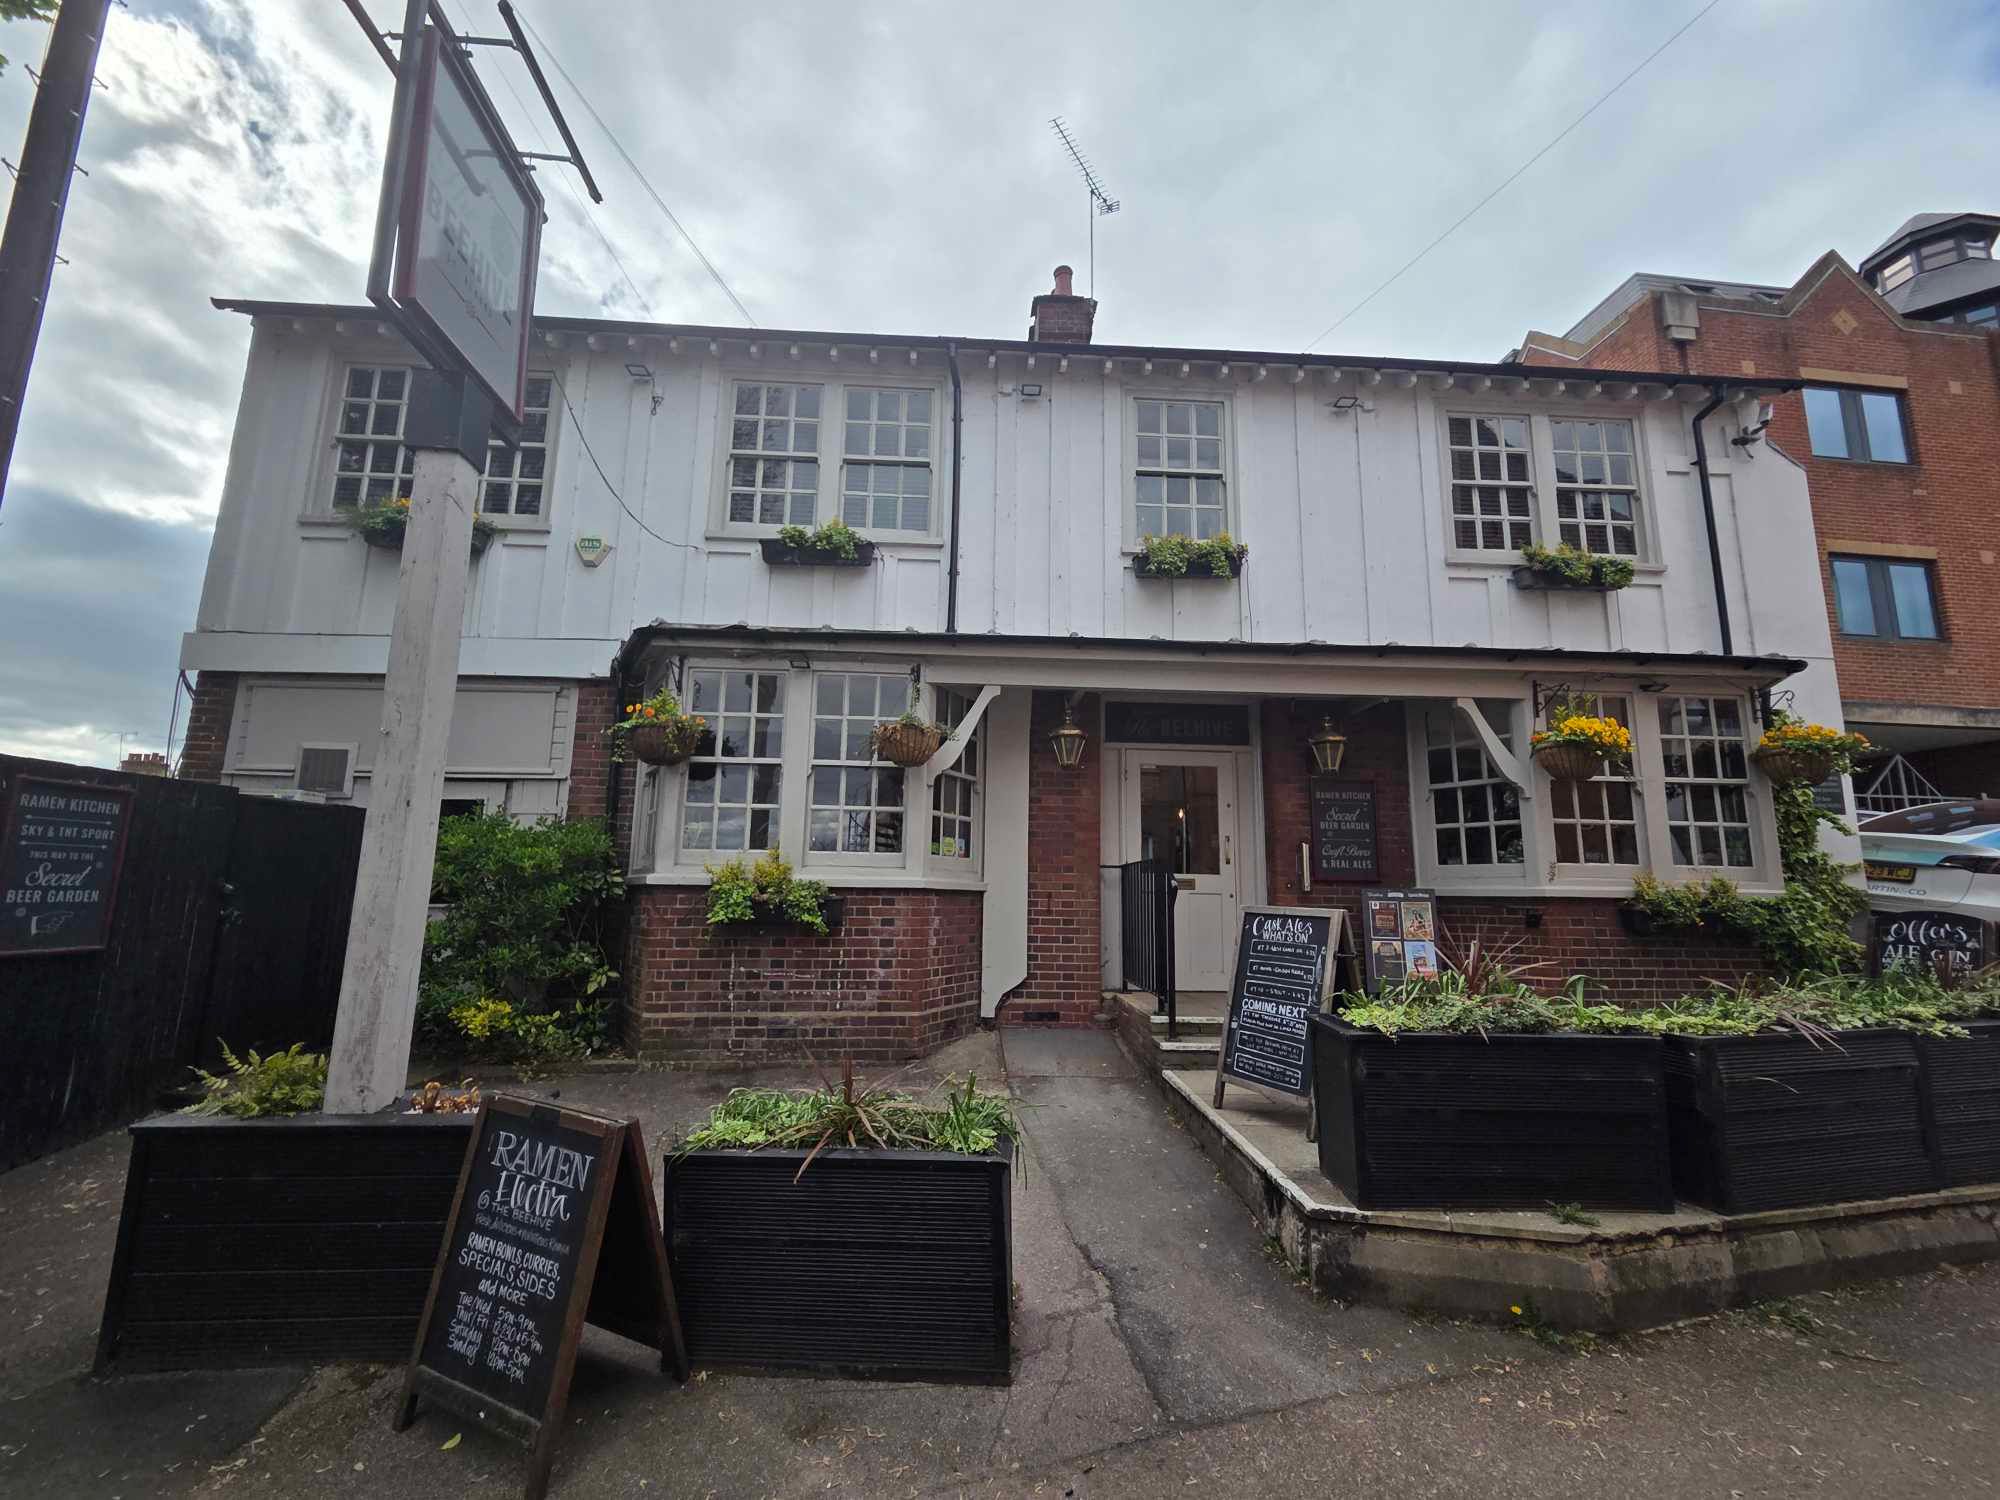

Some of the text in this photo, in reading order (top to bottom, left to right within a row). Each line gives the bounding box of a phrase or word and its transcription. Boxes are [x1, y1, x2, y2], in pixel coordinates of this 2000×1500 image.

[20, 793, 120, 815] RAMEN KITCHEN
[1315, 791, 1371, 800] RAMEN KITCHEN
[1326, 807, 1360, 821] Secret
[21, 824, 115, 840] SKY & TNT SPORT
[1320, 821, 1370, 831] BEER GARDEN
[29, 850, 94, 861] THIS WAY TO THE
[1331, 860, 1350, 869] REAL
[1353, 860, 1372, 869] ALES
[25, 862, 92, 887] Secret
[6, 889, 100, 903] BEER GARDEN
[1252, 915, 1313, 936] Cask Ales
[1262, 929, 1309, 944] WHAT'S ON
[1242, 998, 1307, 1019] COMING NEXT
[491, 1130, 595, 1192] RAMEN
[491, 1201, 510, 1217] THE
[512, 1207, 555, 1232] BEEHIVE
[467, 1231, 497, 1256] RAMEN
[478, 1279, 529, 1307] and MORE
[516, 1270, 556, 1300] SIDES
[447, 1333, 481, 1367] Sunday
